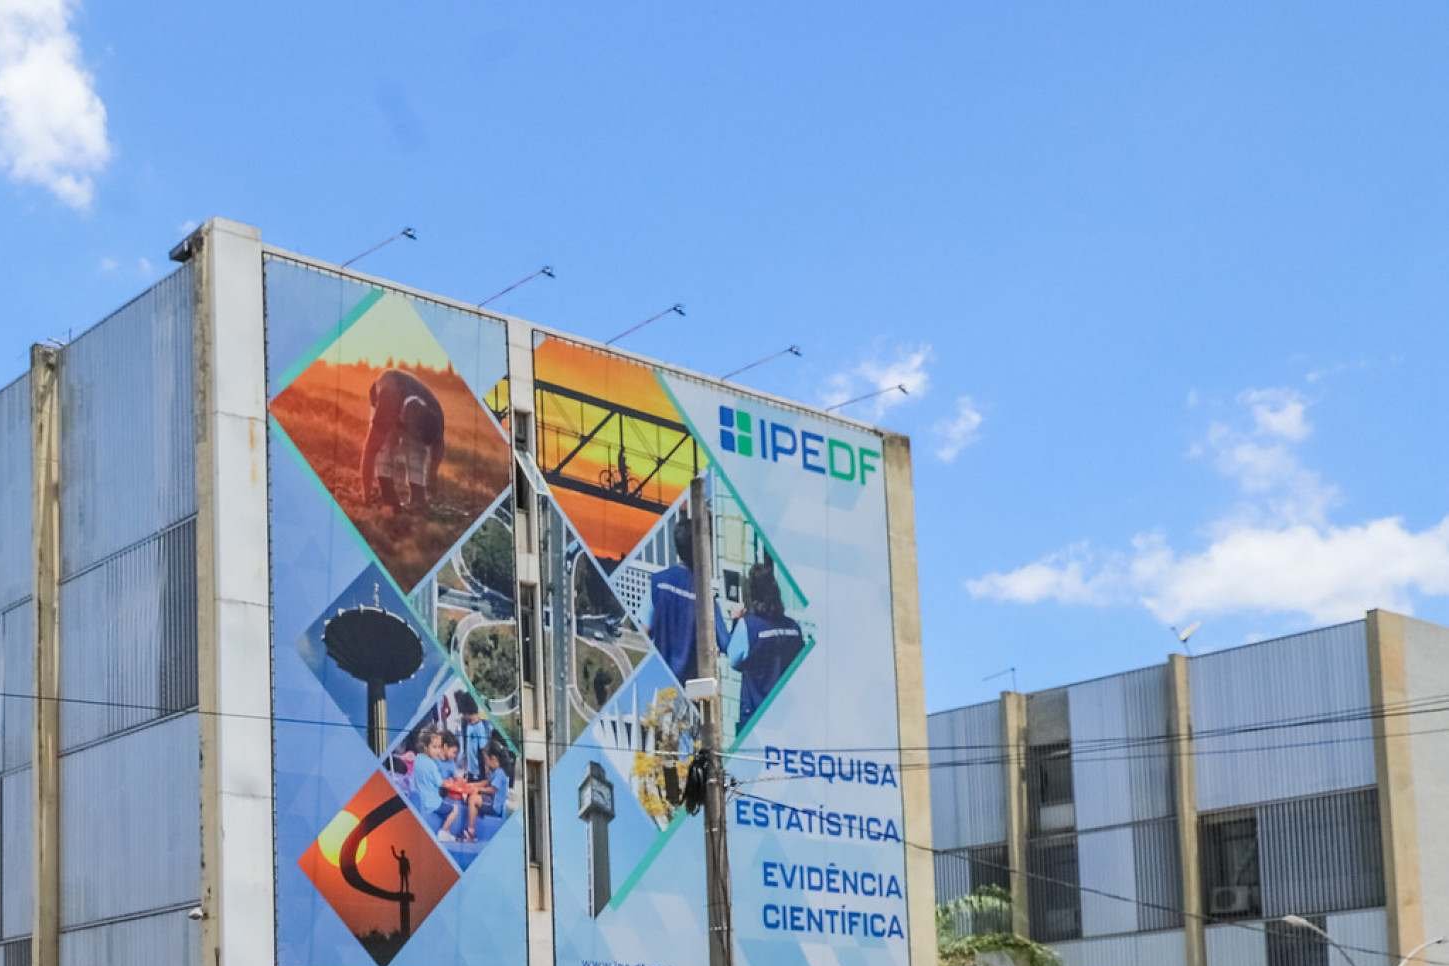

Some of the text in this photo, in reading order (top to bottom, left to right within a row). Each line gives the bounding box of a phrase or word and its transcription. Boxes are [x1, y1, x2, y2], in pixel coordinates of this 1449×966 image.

[760, 418, 882, 486] IPEDF
[764, 745, 898, 788] PESQUISA
[736, 799, 901, 843] ESTATÍSTICA
[763, 861, 902, 899] EVIDÊNCIA
[763, 903, 905, 939] CIENTÍFICA
